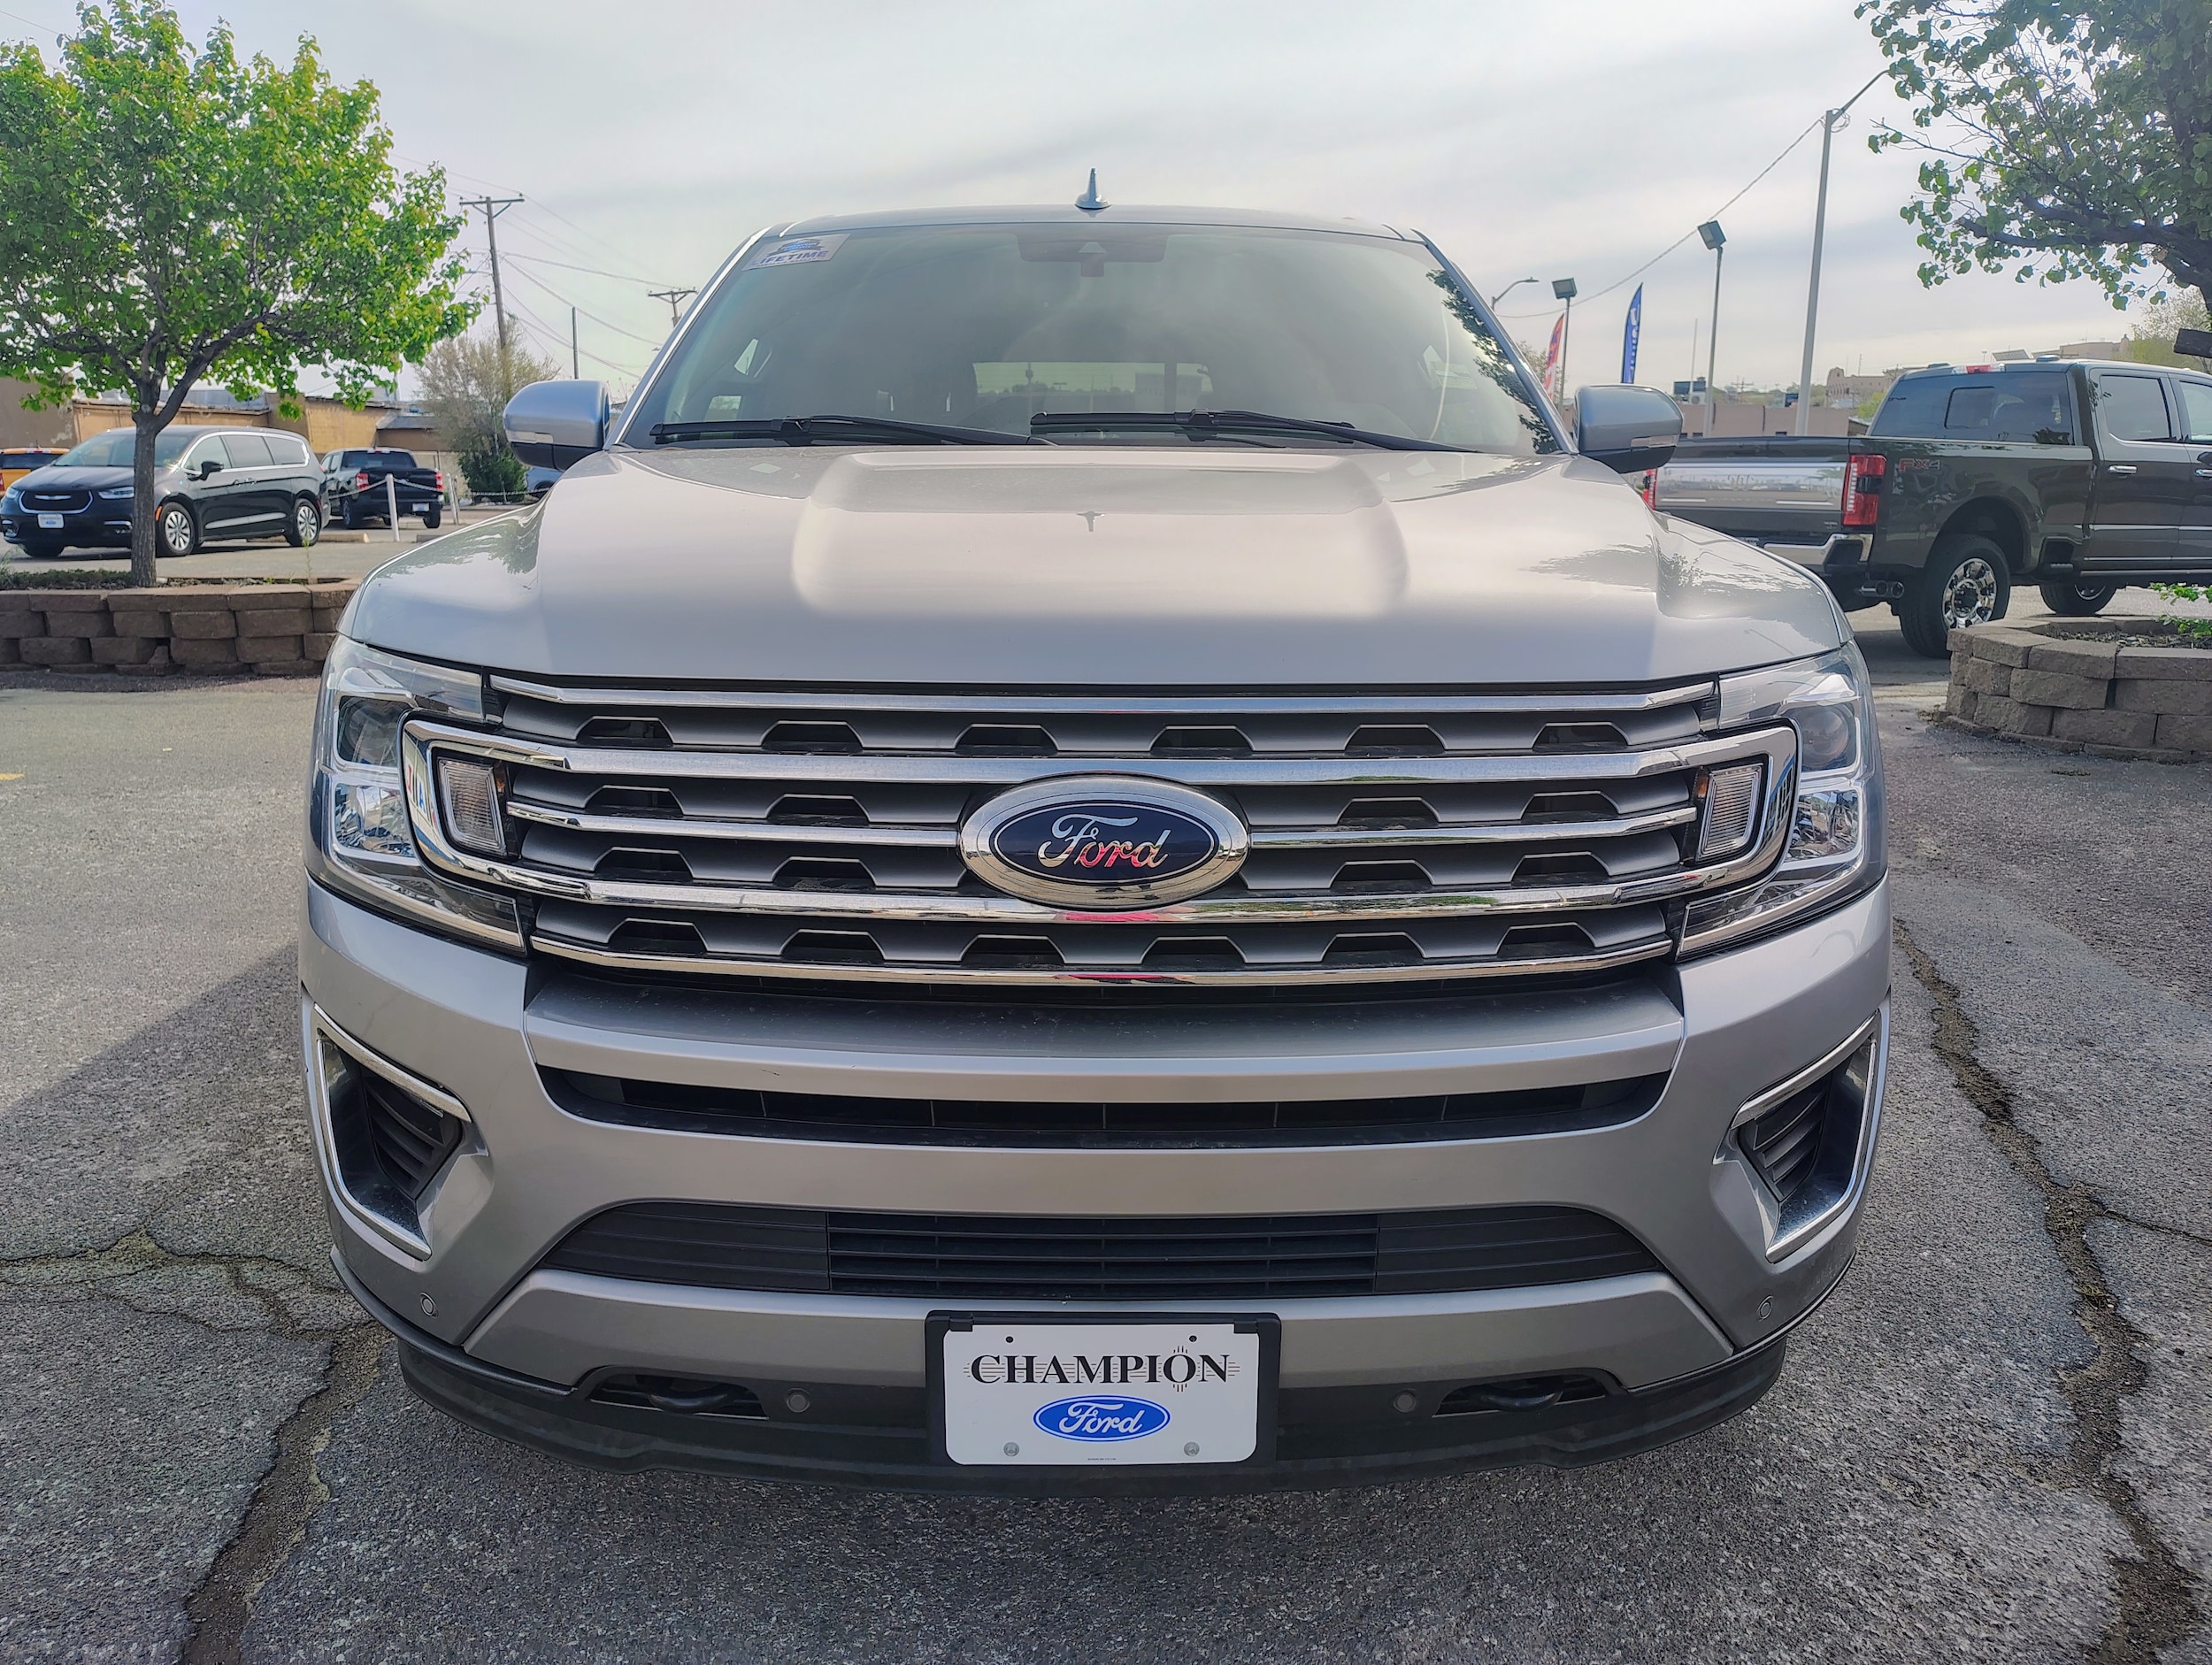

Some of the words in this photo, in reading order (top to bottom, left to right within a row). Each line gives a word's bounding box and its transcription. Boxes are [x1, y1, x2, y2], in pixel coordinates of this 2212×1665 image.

[750, 250, 829, 265] LIFETIME
[1899, 458, 1940, 471] FX4
[1037, 813, 1172, 868] Ford
[971, 1354, 1230, 1385] CHAMPION
[1058, 1401, 1147, 1434] Ford
